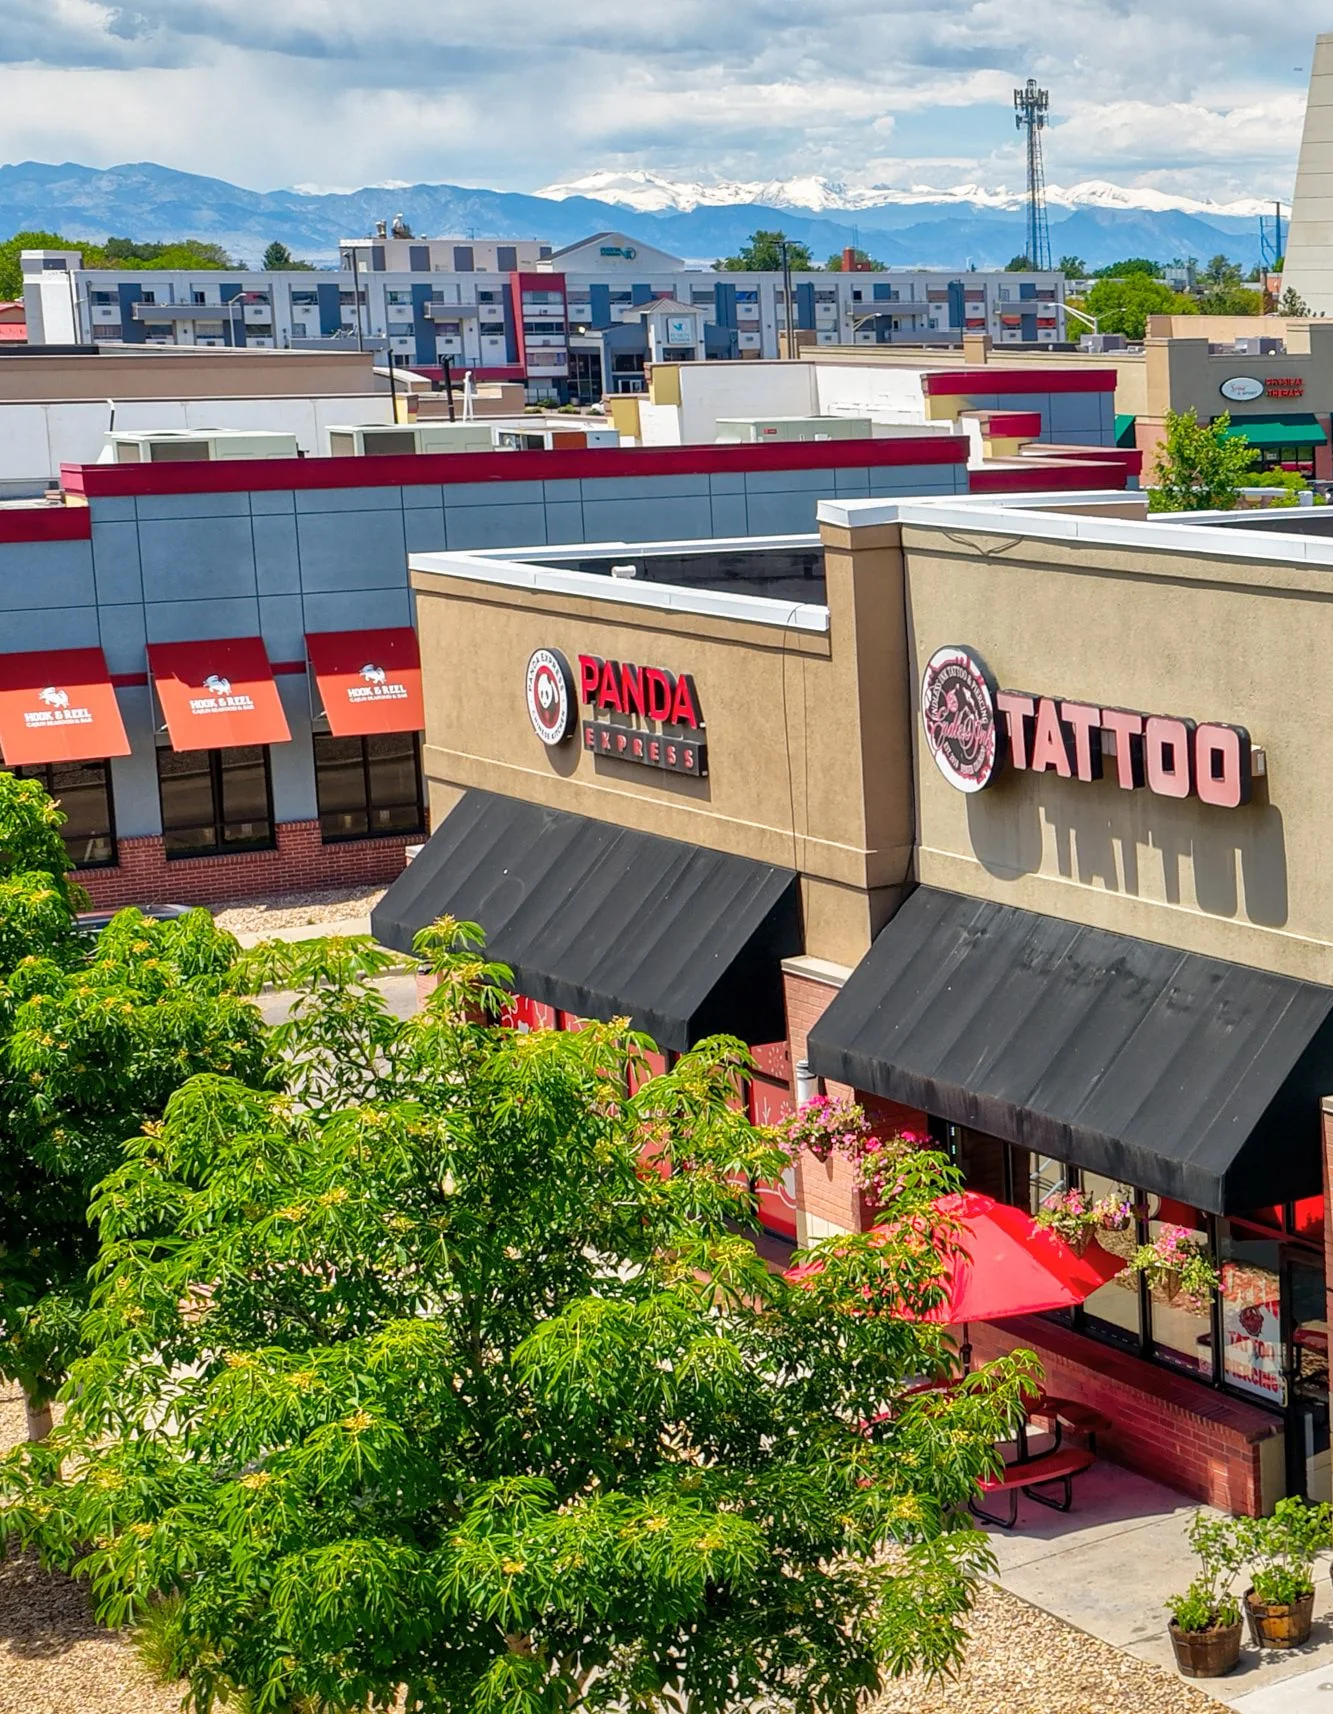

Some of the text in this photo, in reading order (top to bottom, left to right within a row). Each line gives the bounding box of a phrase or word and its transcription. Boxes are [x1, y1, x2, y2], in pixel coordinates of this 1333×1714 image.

[347, 687, 373, 697] HOOK
[382, 684, 407, 694] REEL
[529, 656, 540, 692] PANDA
[578, 654, 699, 729] PANDA
[24, 710, 54, 722] HOOK
[63, 708, 92, 719] REEL
[189, 698, 218, 709] HOOK
[226, 695, 253, 705] REEL
[971, 680, 989, 725] PIERCING
[585, 728, 694, 768] EXPRESS
[997, 690, 1243, 808] TATTOO
